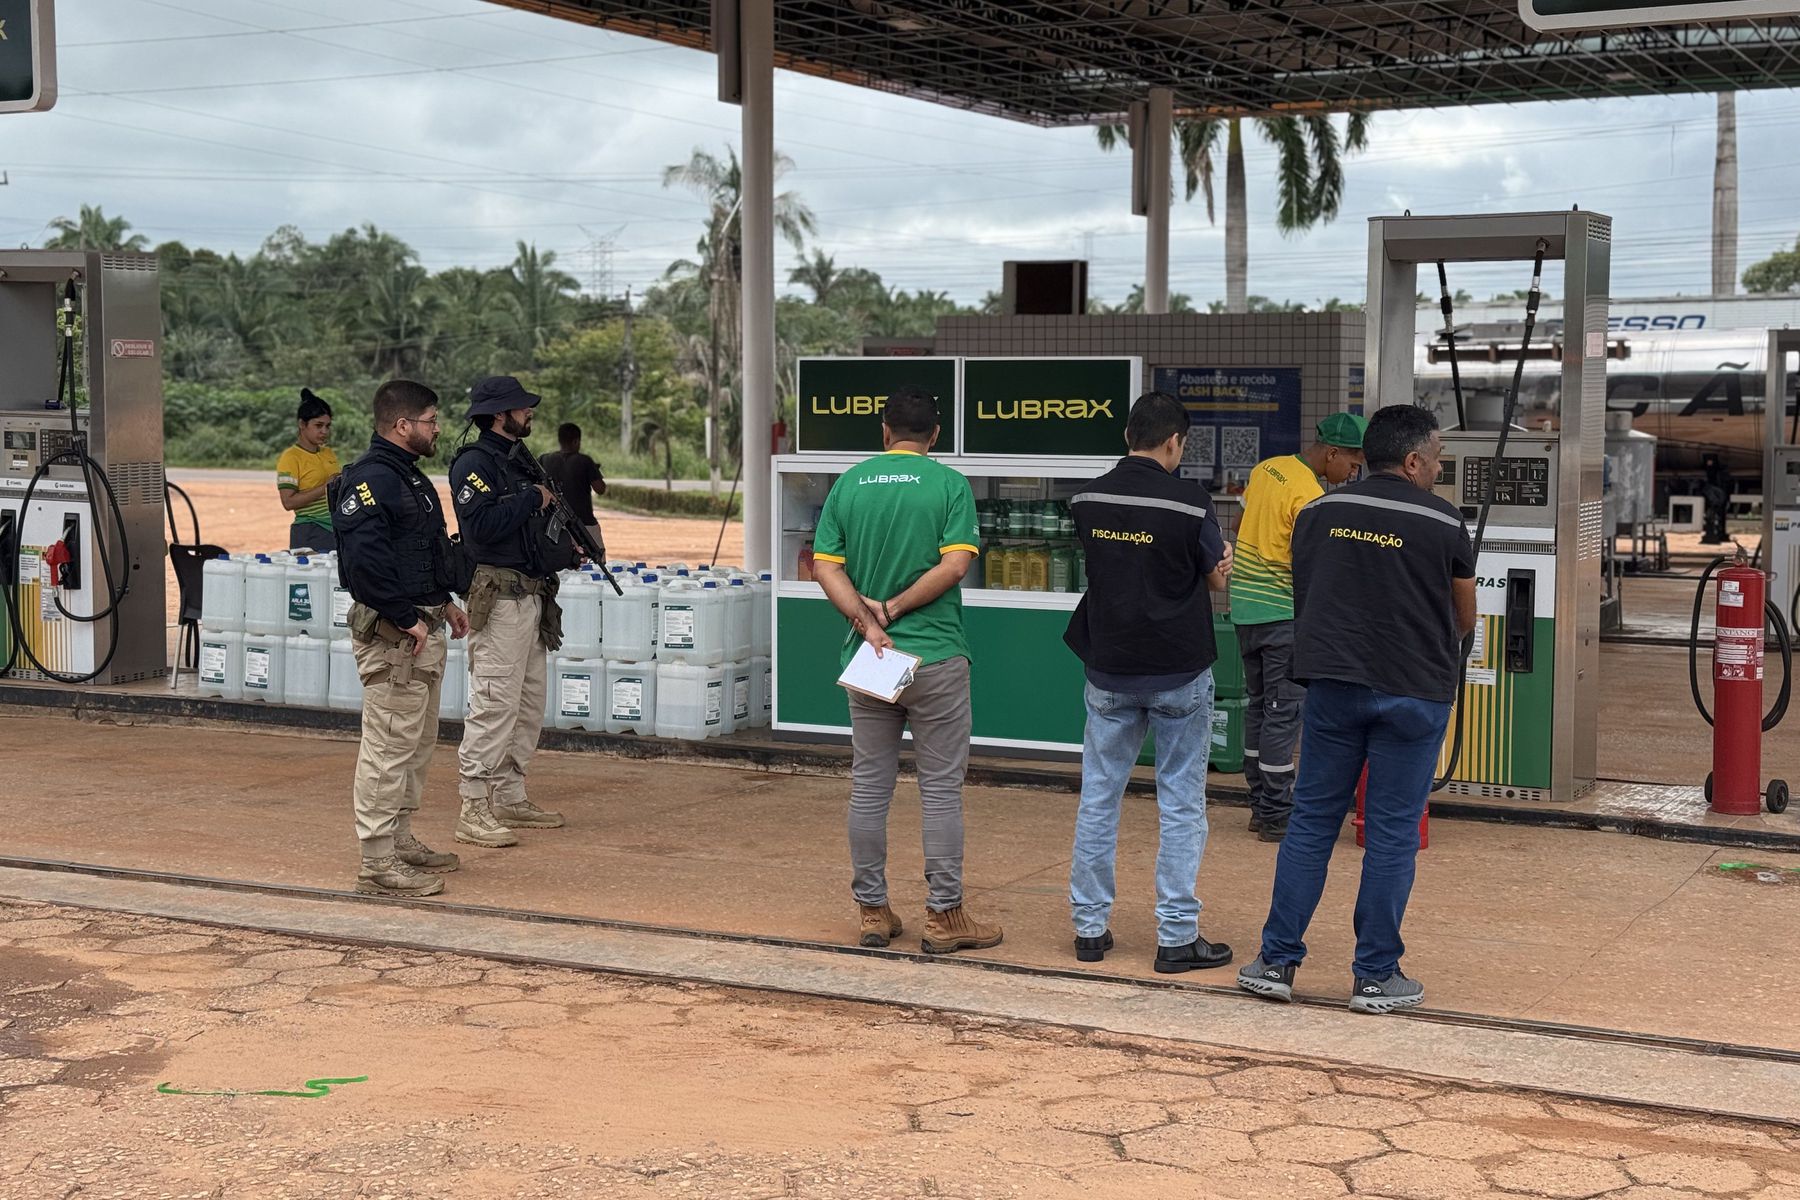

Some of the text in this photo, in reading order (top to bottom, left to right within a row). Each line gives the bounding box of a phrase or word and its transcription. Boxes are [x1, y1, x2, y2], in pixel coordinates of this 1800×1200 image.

[1230, 376, 1237, 385] e
[1239, 373, 1276, 385] receba
[1180, 386, 1210, 396] CASH
[466, 472, 491, 493] PRF
[355, 482, 376, 506] PRF
[1092, 528, 1154, 545] FISCALIZAÇÃO
[1329, 528, 1403, 548] FISCALIZAÇÃO
